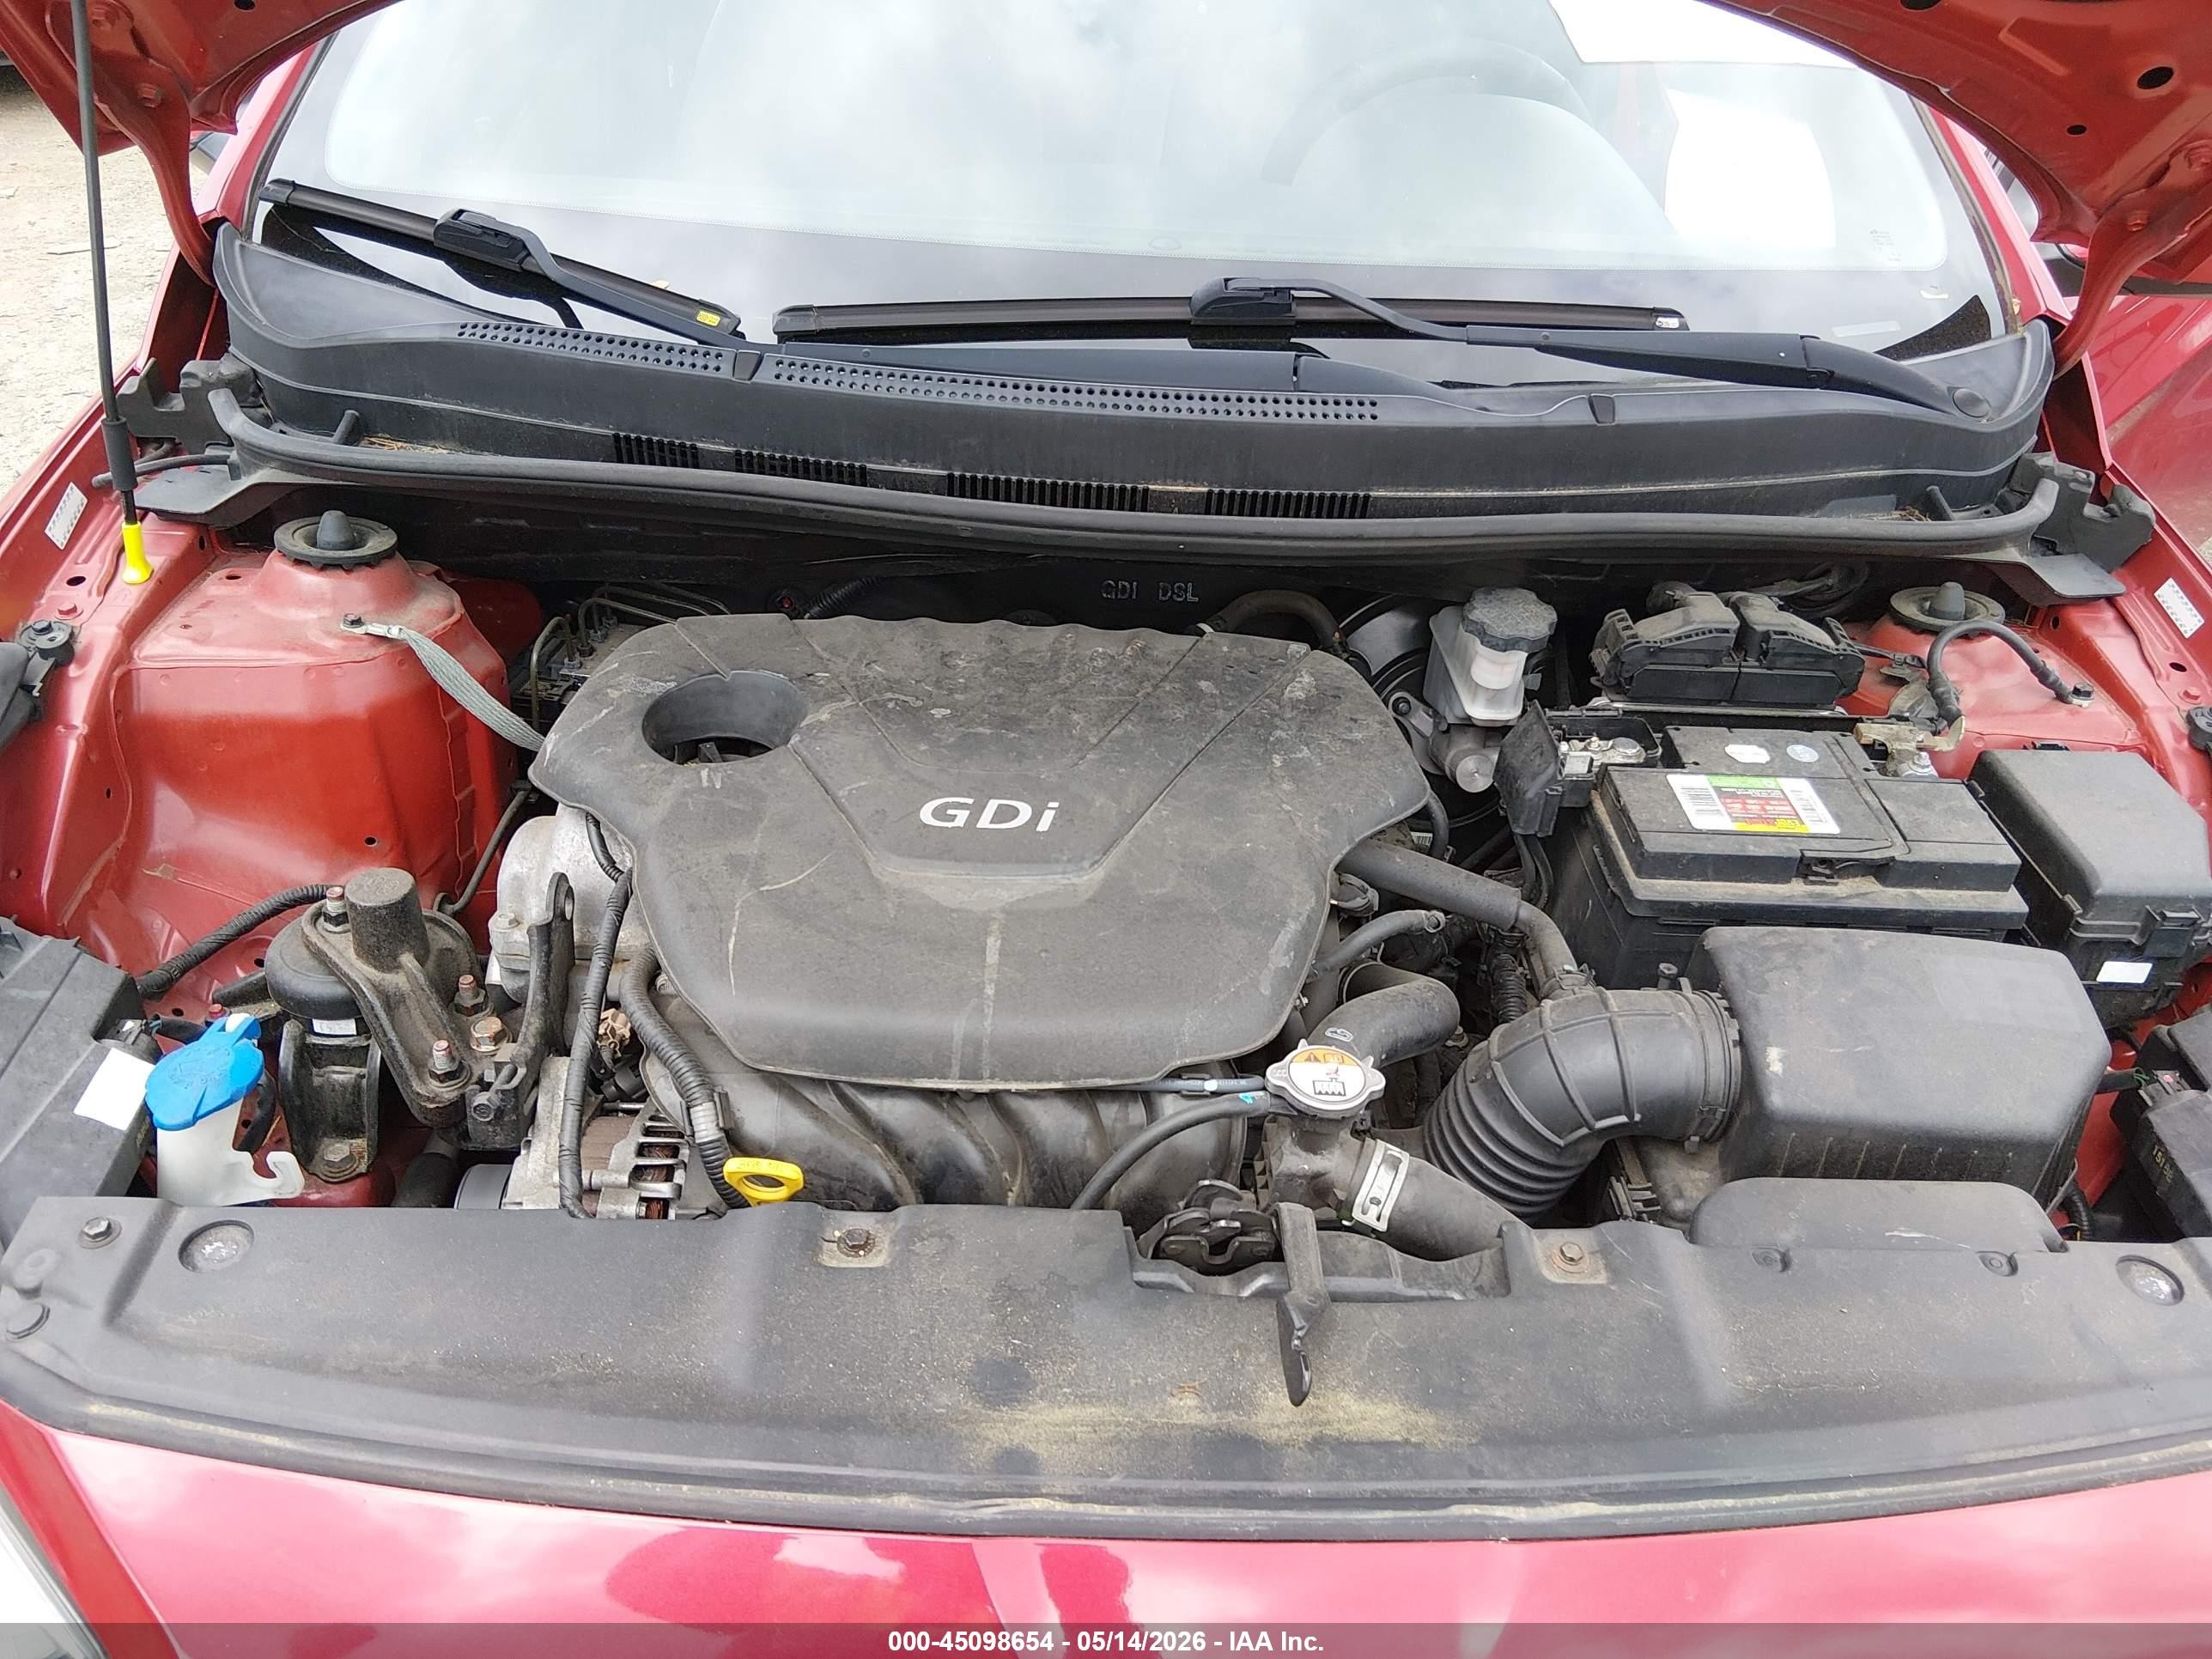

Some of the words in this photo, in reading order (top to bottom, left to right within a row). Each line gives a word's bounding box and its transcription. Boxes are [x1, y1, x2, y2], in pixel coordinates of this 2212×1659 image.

[1100, 580, 1138, 600] GDI
[1158, 582, 1200, 602] DSL
[919, 796, 1060, 832] GDi
